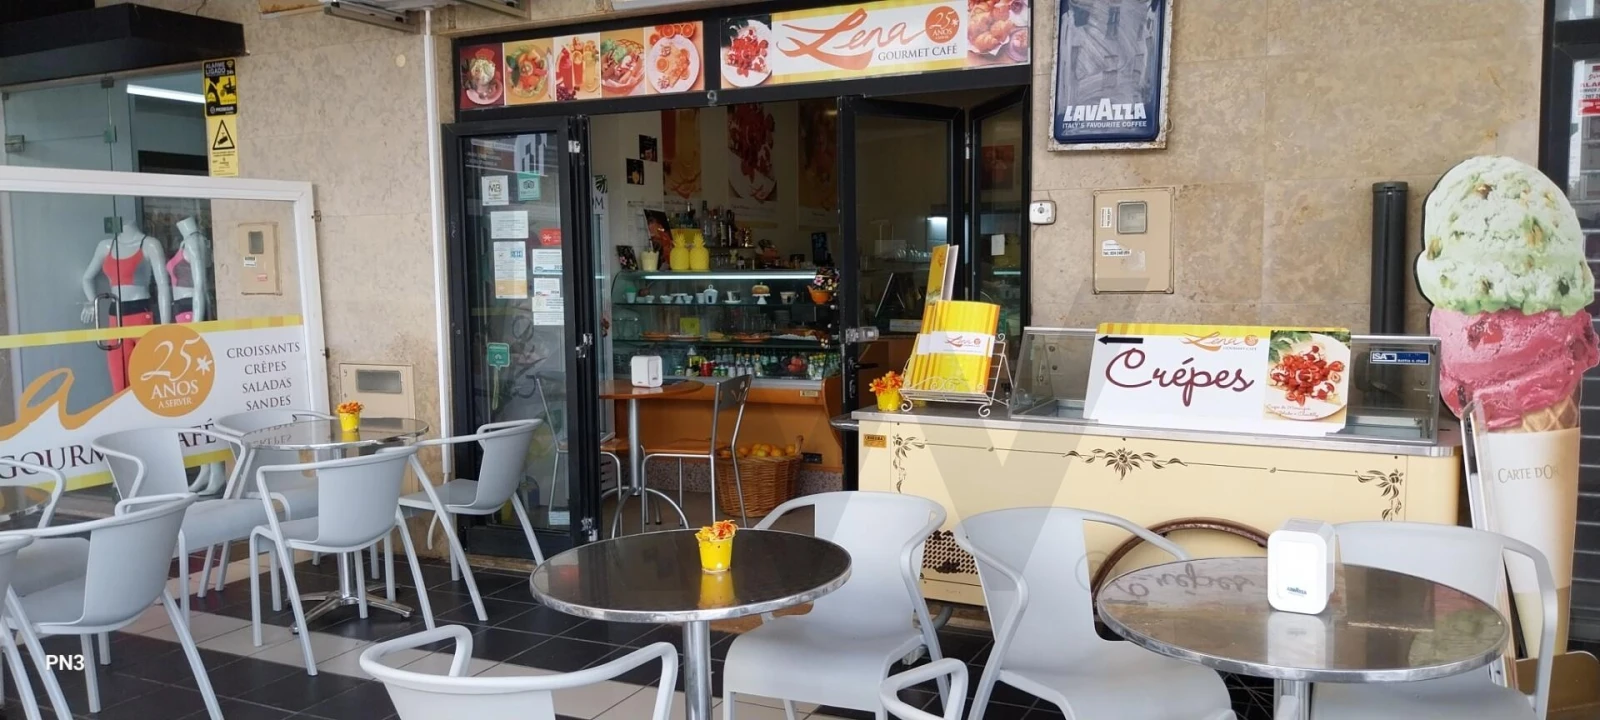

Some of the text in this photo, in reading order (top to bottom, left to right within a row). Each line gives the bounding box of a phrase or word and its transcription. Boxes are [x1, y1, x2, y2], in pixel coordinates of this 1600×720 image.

[929, 11, 955, 29] 25
[776, 7, 923, 71] Lena
[878, 43, 958, 61] GOURMET CAFÉ
[1063, 98, 1146, 122] LAVAZZA
[1062, 120, 1147, 129] ITALY'S FAVOURITE COFFEE
[141, 335, 201, 381] 25
[226, 342, 301, 359] CROISSANTS
[244, 360, 287, 375] CRÊPES
[242, 377, 292, 394] SALADAS
[1105, 347, 1255, 407] Crépes
[151, 379, 199, 400] ANOS
[158, 397, 192, 409] A SERVIR
[246, 395, 291, 412] SANDES
[0, 443, 105, 480] GOURM
[178, 418, 216, 448] AFÉ
[1498, 467, 1532, 484] CARTE
